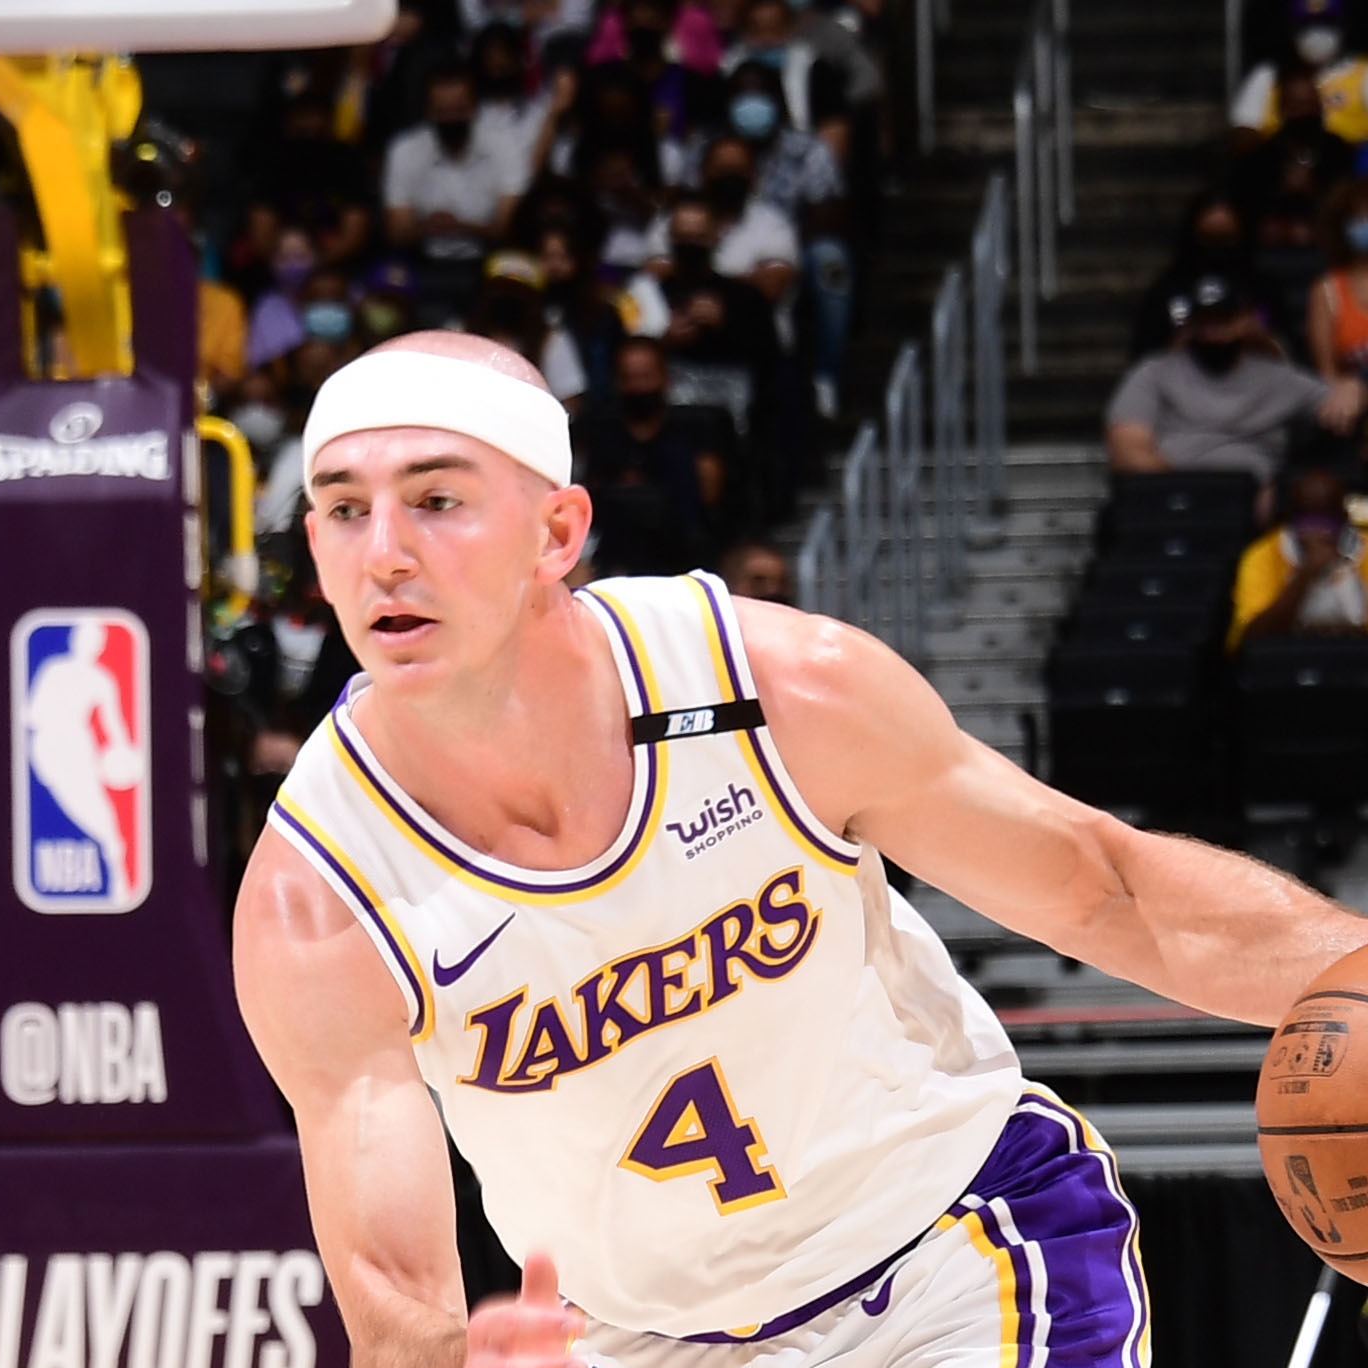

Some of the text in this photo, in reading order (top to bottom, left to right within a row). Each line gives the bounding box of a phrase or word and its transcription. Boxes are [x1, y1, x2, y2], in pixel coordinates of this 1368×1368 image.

[666, 783, 756, 844] wish
[685, 810, 763, 859] SHOPPING
[37, 840, 103, 892] NBA
[457, 865, 823, 1094] LAKERS
[0, 1000, 168, 1106] @NBA
[617, 1056, 788, 1216] 4
